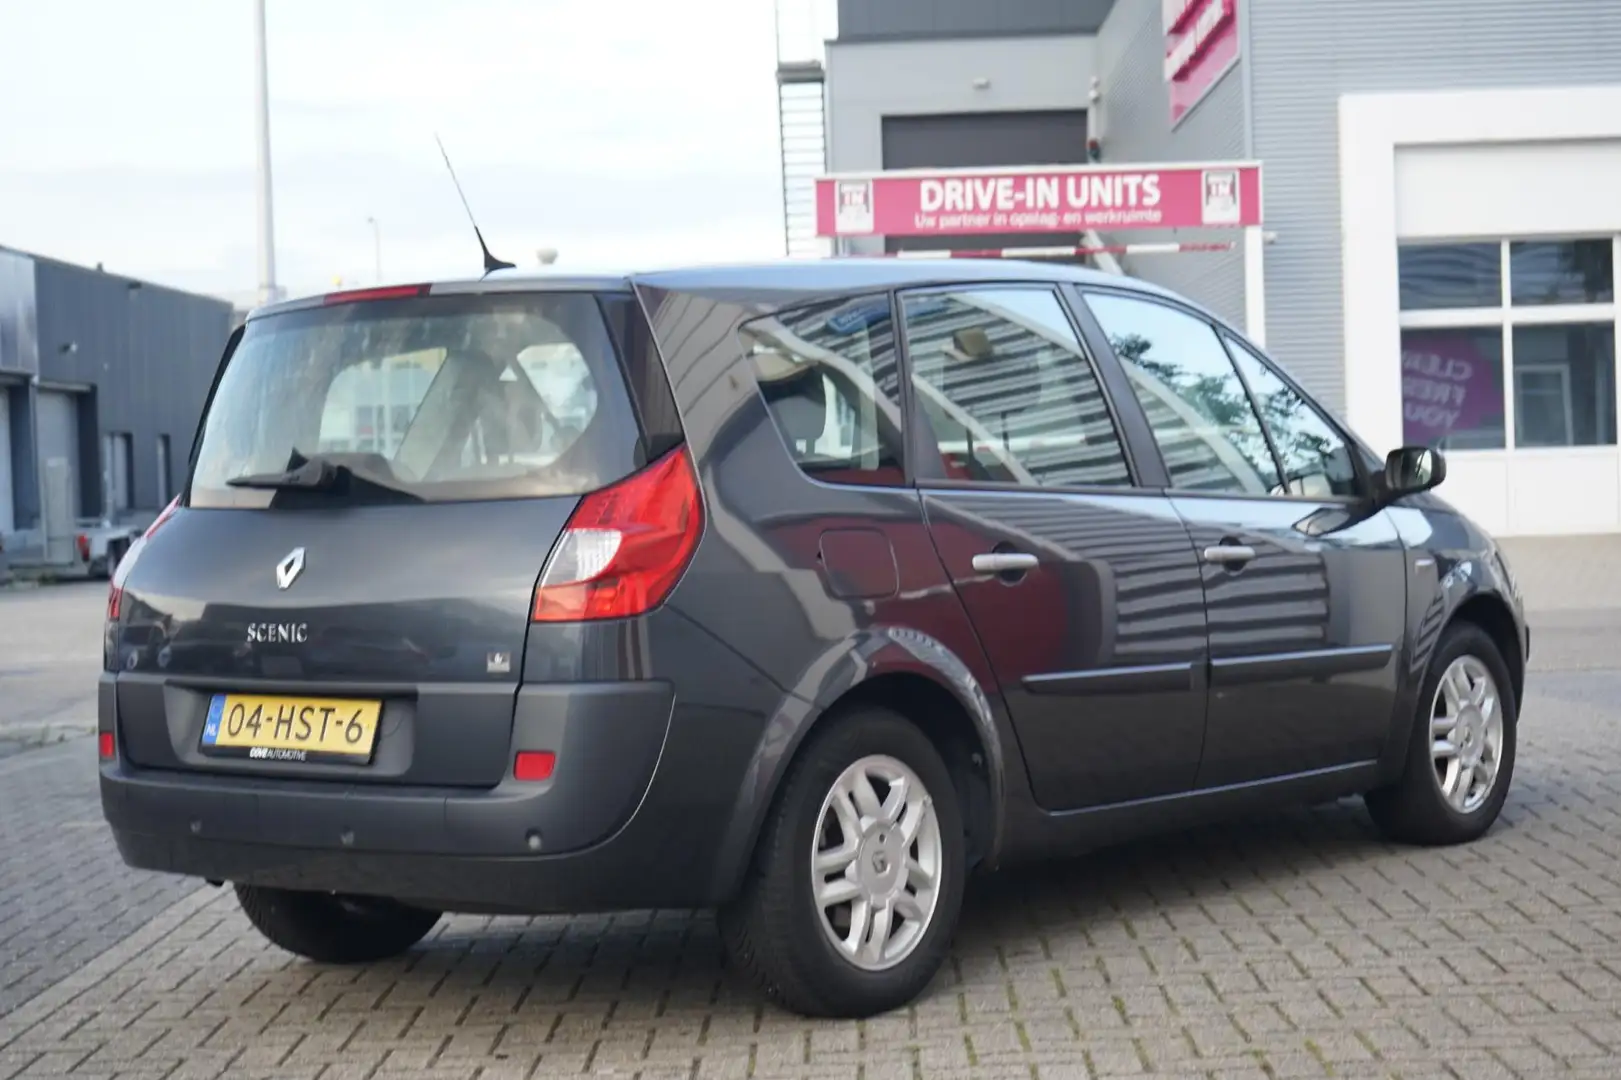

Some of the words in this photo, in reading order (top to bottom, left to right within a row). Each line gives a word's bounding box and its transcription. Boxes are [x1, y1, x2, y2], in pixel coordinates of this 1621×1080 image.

[919, 175, 1059, 213] DRIVE-IN
[1066, 174, 1161, 209] UNITS
[246, 622, 308, 643] SCENIC
[205, 724, 218, 737] NL
[227, 702, 363, 744] 04-HST-6
